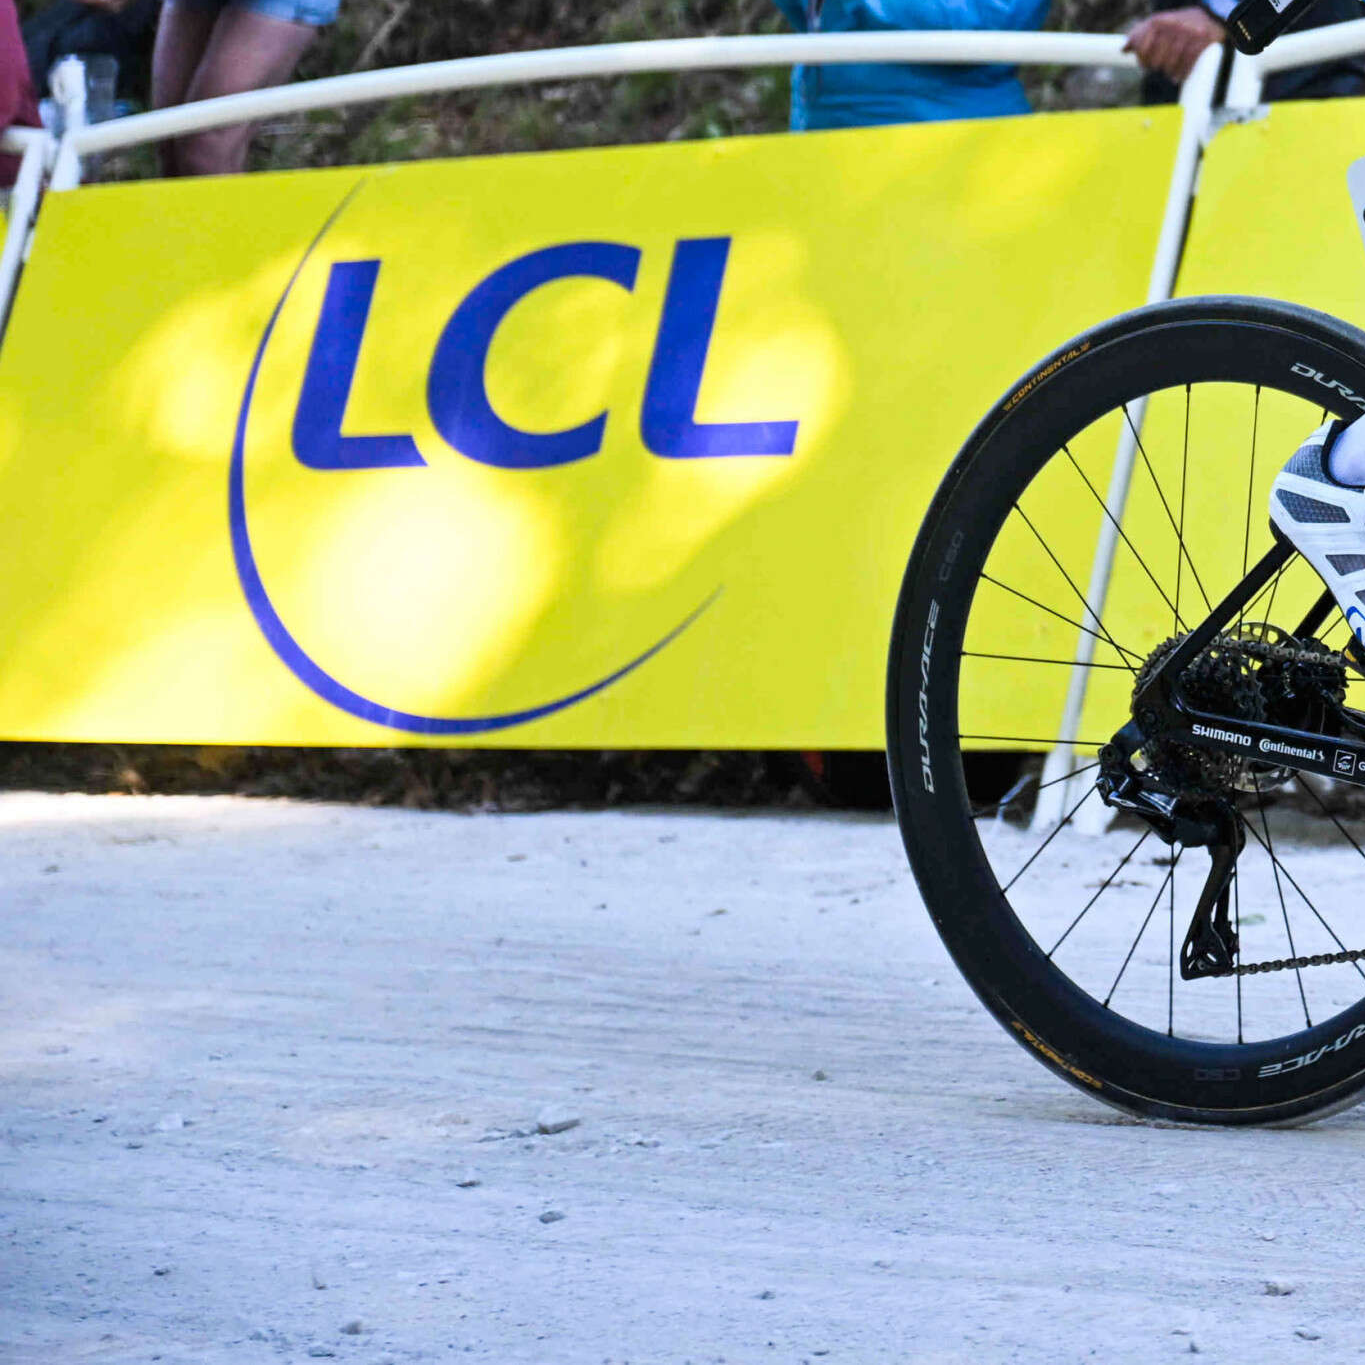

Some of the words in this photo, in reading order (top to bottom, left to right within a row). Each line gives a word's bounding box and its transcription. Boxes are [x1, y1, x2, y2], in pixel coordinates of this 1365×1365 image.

[290, 236, 801, 471] LCL
[1011, 349, 1081, 405] CONTINENTAL
[919, 598, 940, 795] DURA-ACE
[1191, 723, 1252, 746] SHIMANO
[1258, 737, 1317, 761] Continental
